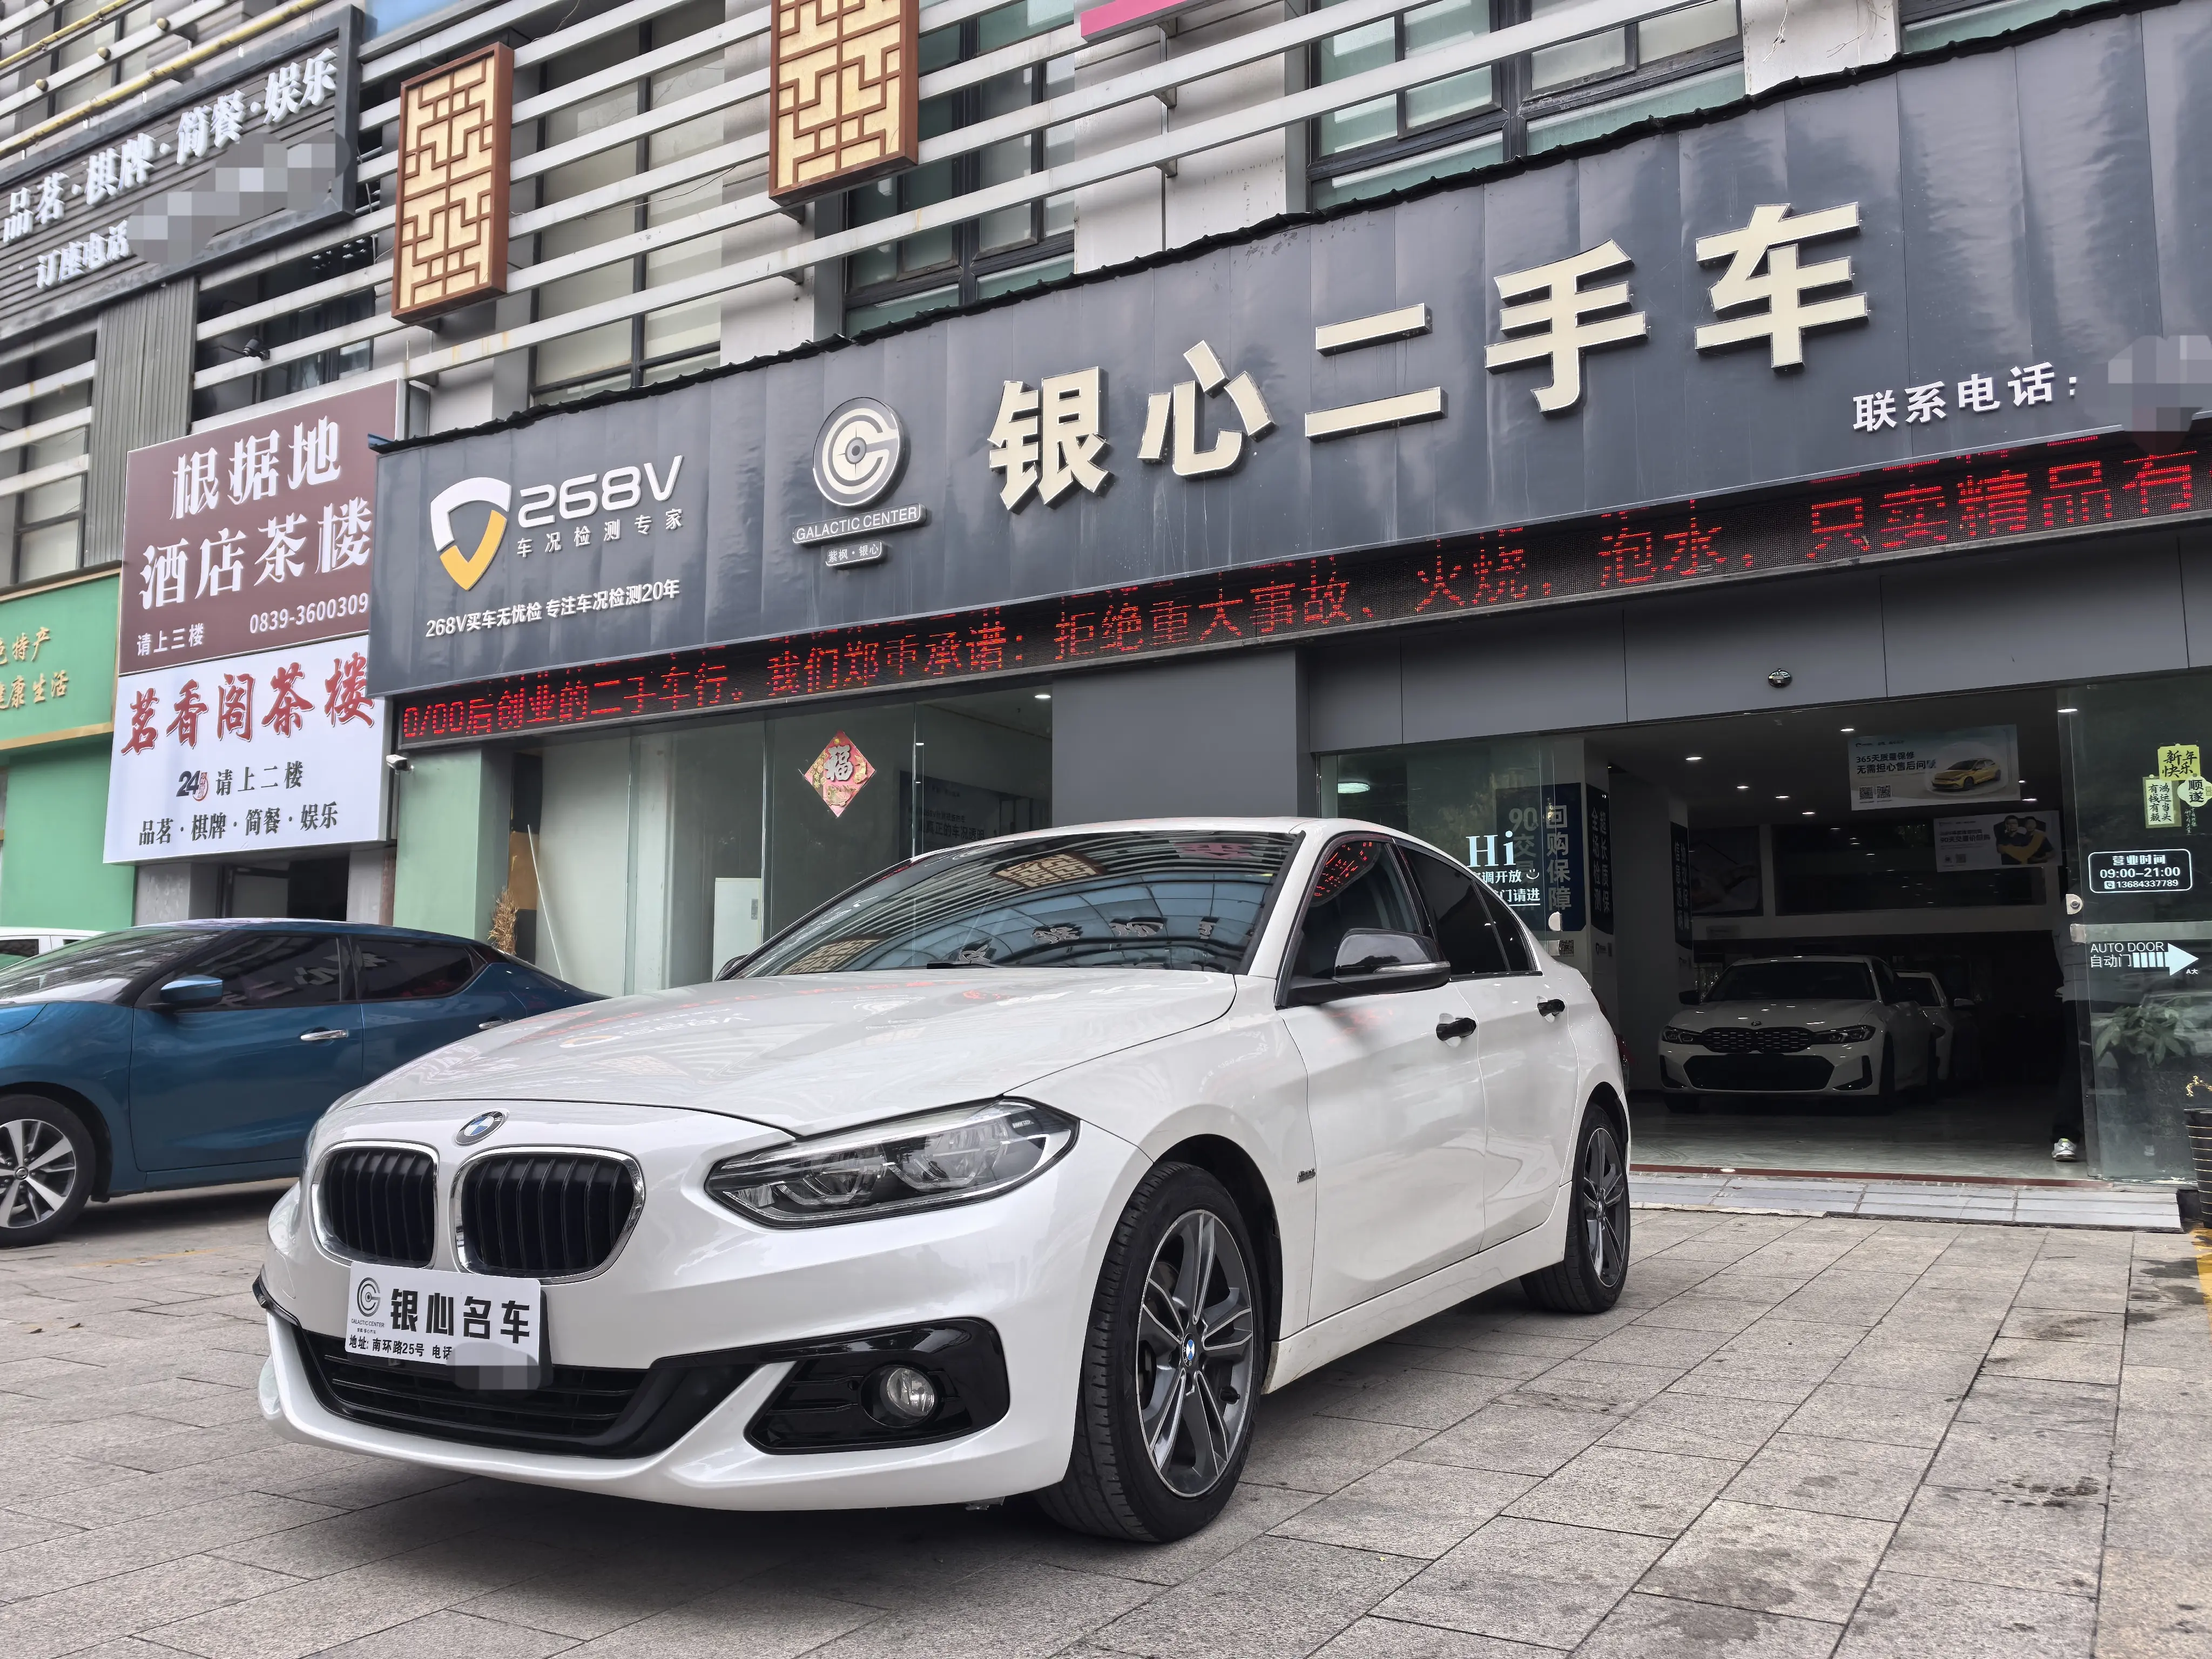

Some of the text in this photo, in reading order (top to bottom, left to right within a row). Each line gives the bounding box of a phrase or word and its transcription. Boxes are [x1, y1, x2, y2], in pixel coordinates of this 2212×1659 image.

[988, 201, 1870, 513] 银心二手车
[169, 415, 341, 520] 根据地
[518, 455, 684, 528] 268V
[517, 508, 683, 558] 车况检测专家
[797, 507, 916, 540] GALACTIC CENTER
[139, 497, 372, 609] 酒店茶楼
[249, 592, 368, 633] 0839-3600309
[426, 579, 680, 638] 268V买车无忧检 专注车况检测20年
[137, 623, 204, 656] 请上三楼
[121, 652, 374, 755] 茗香阁茶楼
[824, 745, 853, 781] 福
[2162, 762, 2193, 778] 快乐
[2163, 750, 2197, 765] 新年
[215, 760, 303, 795] 请上二楼
[2188, 779, 2204, 802] 顺遂
[1466, 830, 1516, 867] Hi
[1546, 805, 1572, 911] 回购保障
[2112, 854, 2166, 865] 营业时间
[2116, 879, 2179, 888] 13684337789
[2090, 941, 2164, 953] AUTO DOOR
[2090, 954, 2132, 968] 自动门
[390, 1289, 530, 1344] 银心名车
